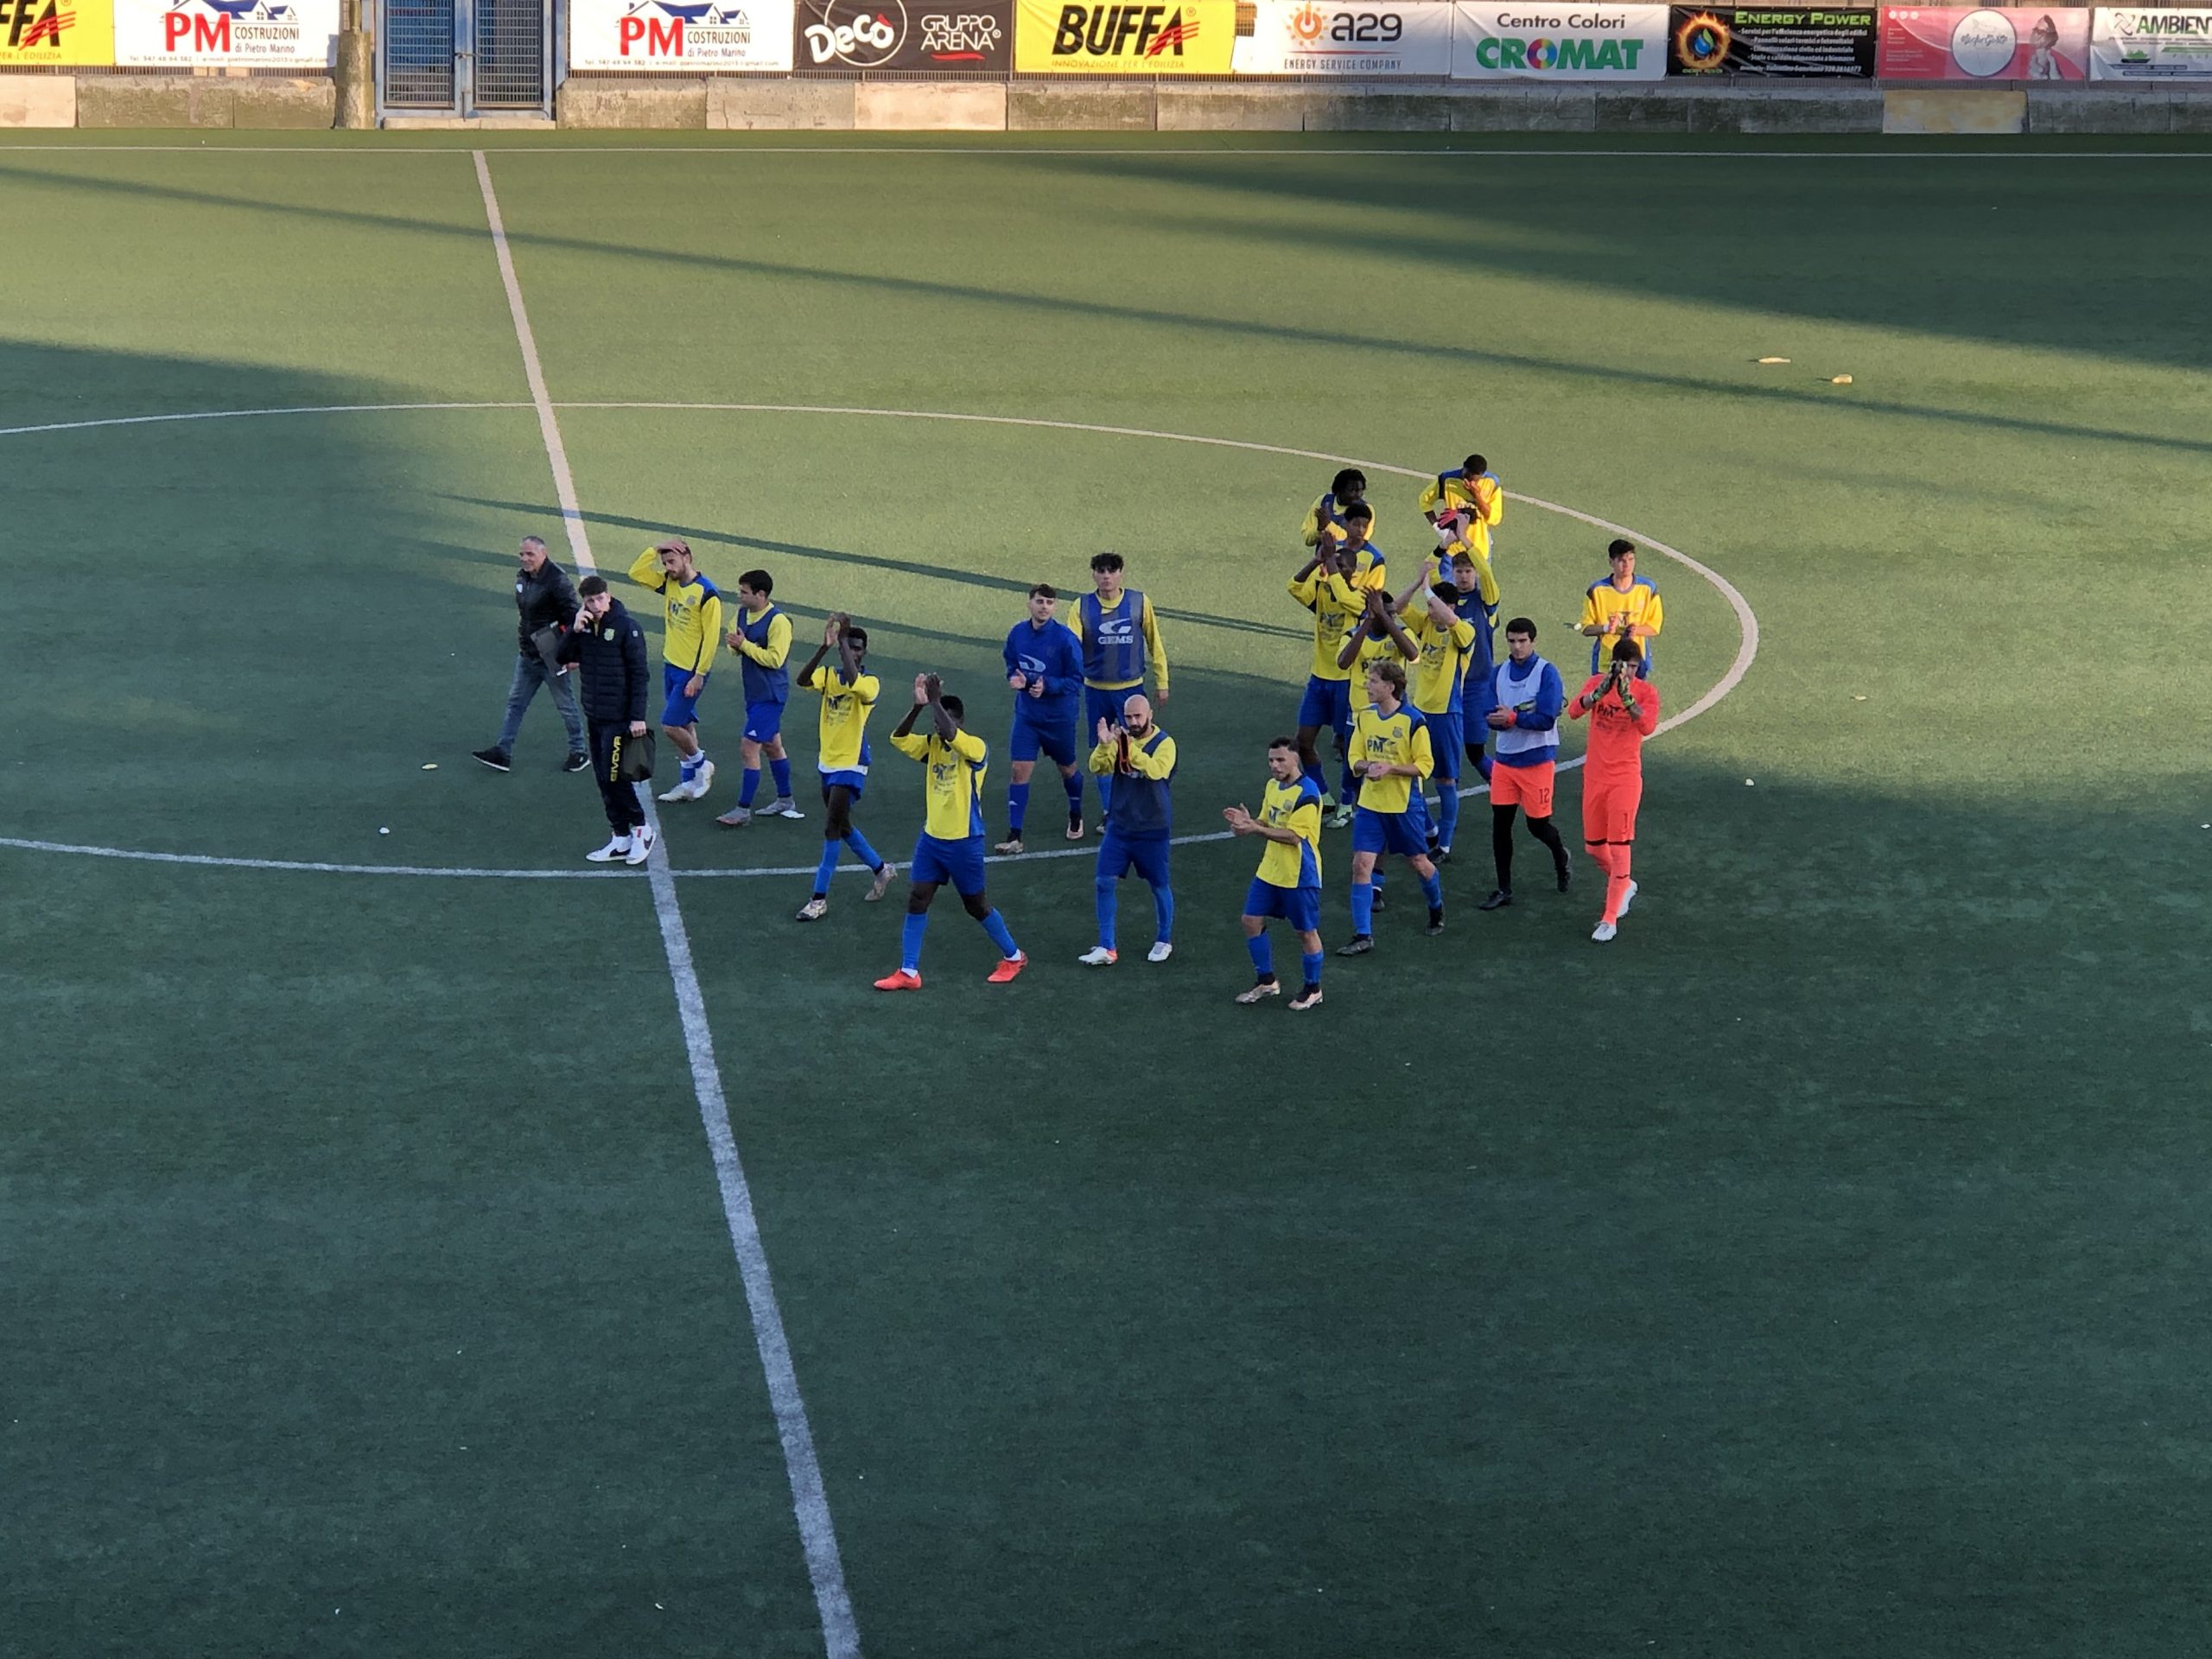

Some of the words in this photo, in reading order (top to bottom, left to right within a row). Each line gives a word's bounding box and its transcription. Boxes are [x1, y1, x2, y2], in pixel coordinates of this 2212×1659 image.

[920, 15, 996, 32] GRUPPO
[1497, 13, 1560, 29] Centro
[1567, 13, 1625, 29] Colori
[1734, 11, 1807, 25] ENERGY
[1809, 12, 1871, 25] POWER
[165, 12, 231, 53] PM
[234, 27, 300, 40] COSTRUZIONI
[620, 16, 683, 57] PM
[688, 31, 751, 43] COSTRUZIONI
[1052, 5, 1185, 56] BUFFA
[235, 43, 242, 53] di
[245, 43, 267, 54] Pietro
[270, 44, 296, 54] Marino
[920, 32, 995, 51] ARENA
[688, 48, 695, 57] di
[697, 48, 719, 57] Pietro
[721, 48, 747, 57] Marino
[1476, 37, 1643, 70] CROMAT
[1052, 60, 1119, 68] INNOVAZIONE
[1123, 60, 1138, 68] PER
[1284, 59, 1316, 69] ENERGY
[1320, 59, 1357, 70] SERVICE
[1360, 59, 1402, 70] COMPANY
[1097, 635, 1134, 645] GEMS
[1367, 739, 1383, 753] PM
[609, 735, 622, 782] GIVOVA
[1539, 787, 1550, 804] 12
